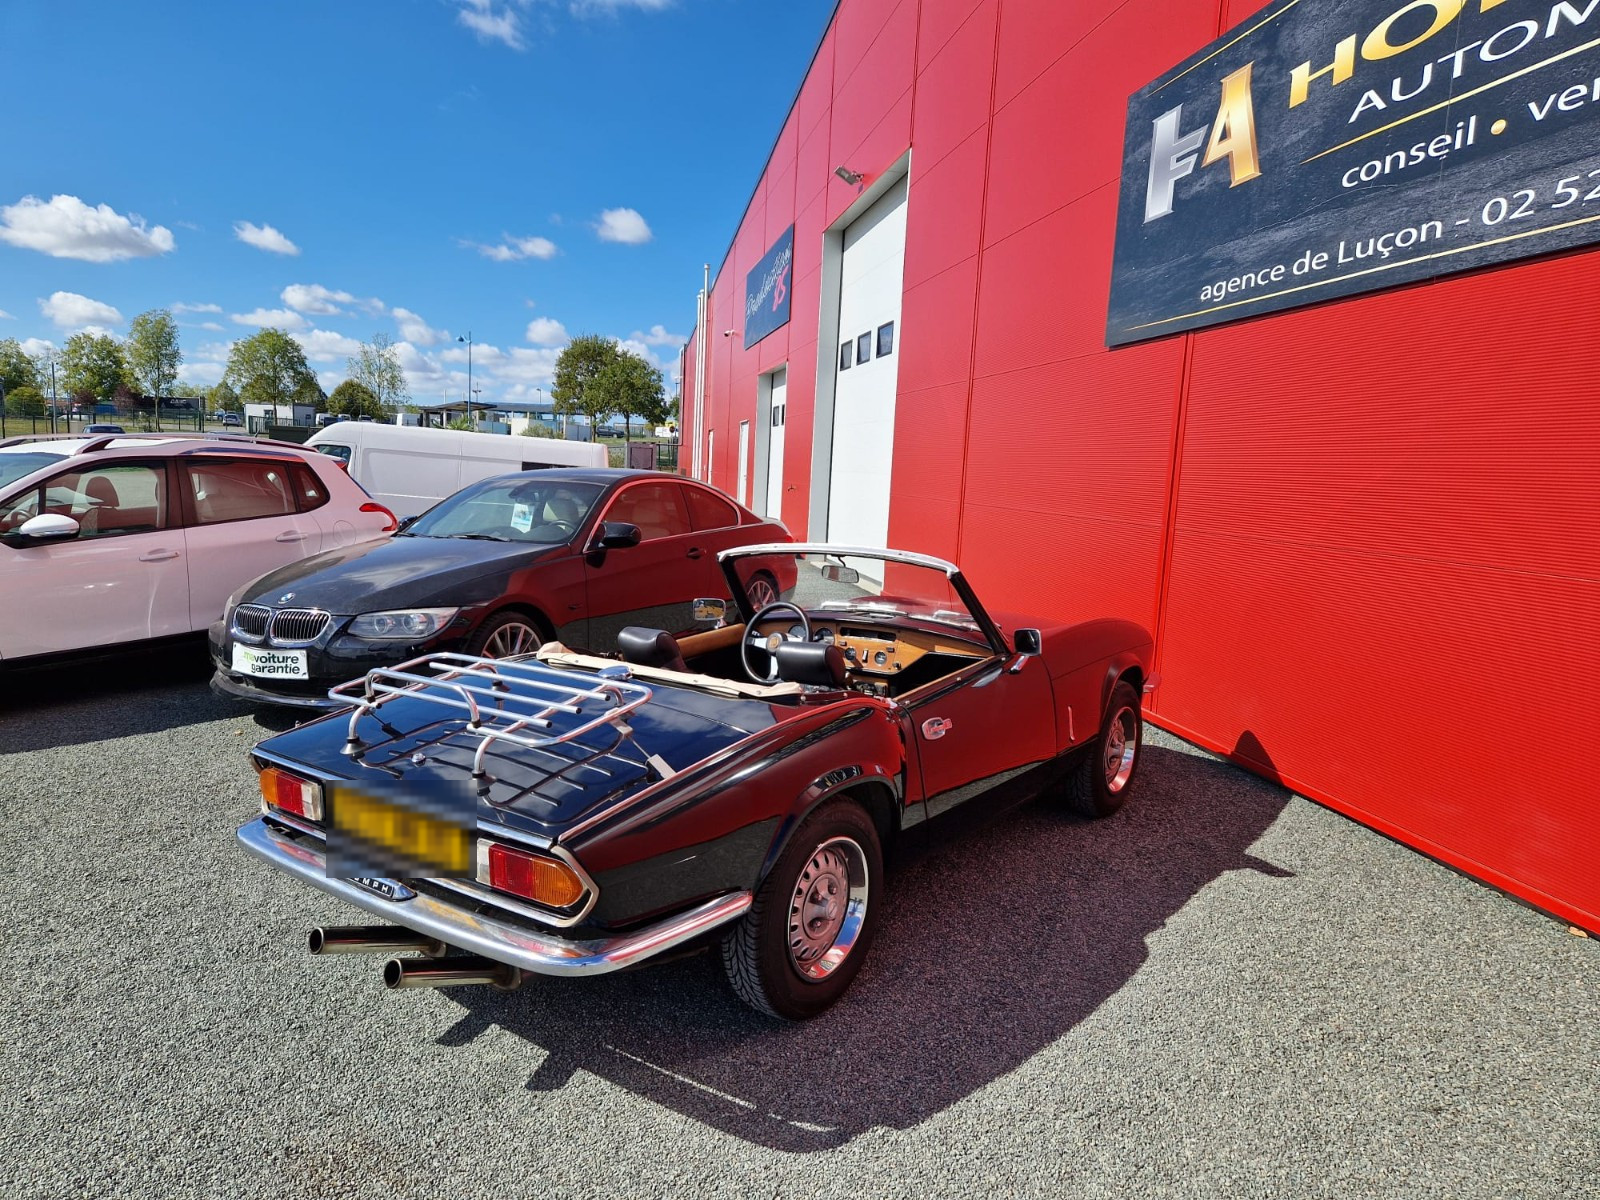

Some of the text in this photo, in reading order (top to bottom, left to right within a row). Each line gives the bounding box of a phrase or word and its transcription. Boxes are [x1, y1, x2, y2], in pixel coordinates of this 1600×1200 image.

[1289, 0, 1507, 109] HO
[1341, 115, 1477, 188] conseil
[1200, 264, 1285, 302] agence
[1292, 250, 1328, 275] de
[1337, 219, 1442, 264] Luçon
[1481, 189, 1535, 225] 02
[251, 663, 301, 675] garantie
